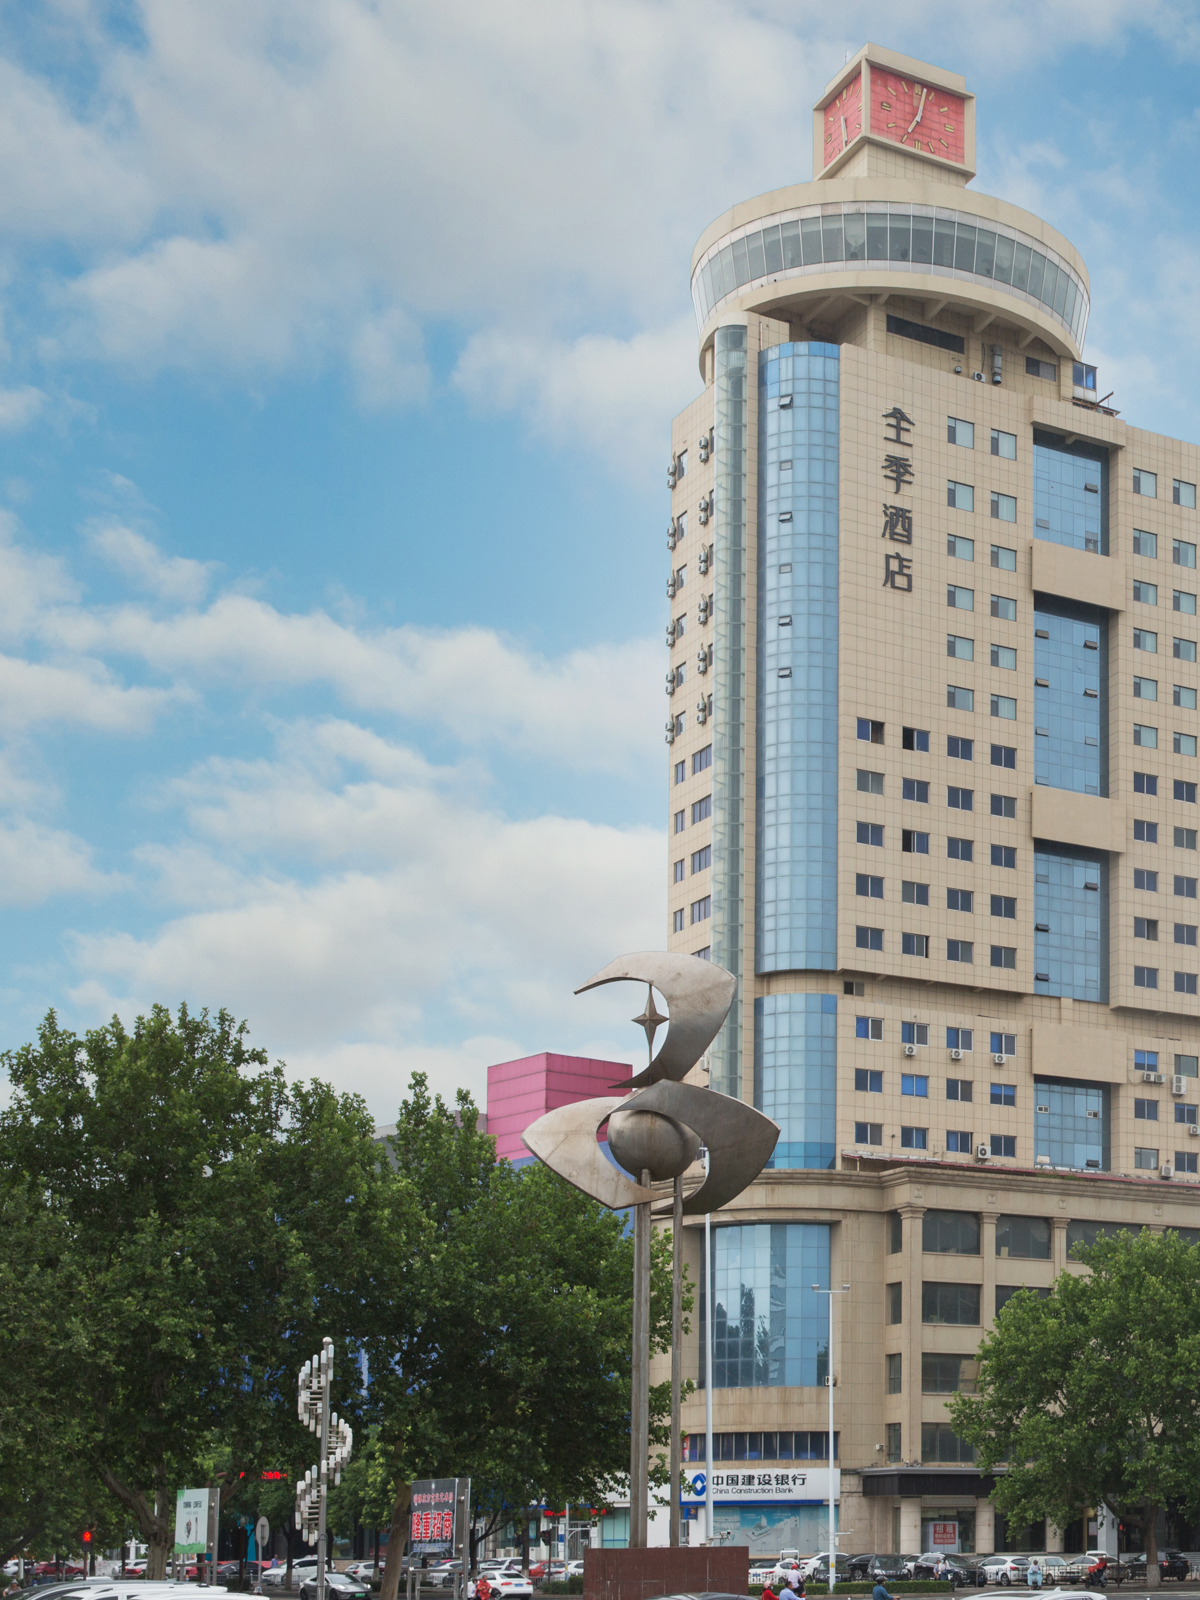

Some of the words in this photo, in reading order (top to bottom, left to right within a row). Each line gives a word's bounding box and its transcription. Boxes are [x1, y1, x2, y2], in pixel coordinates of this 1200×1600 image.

[881, 407, 916, 592] 全季酒店
[712, 1473, 807, 1487] 中国建设银行
[775, 1486, 794, 1494] Bank
[412, 1510, 452, 1540] 隆重招商
[936, 1525, 953, 1533] 招租
